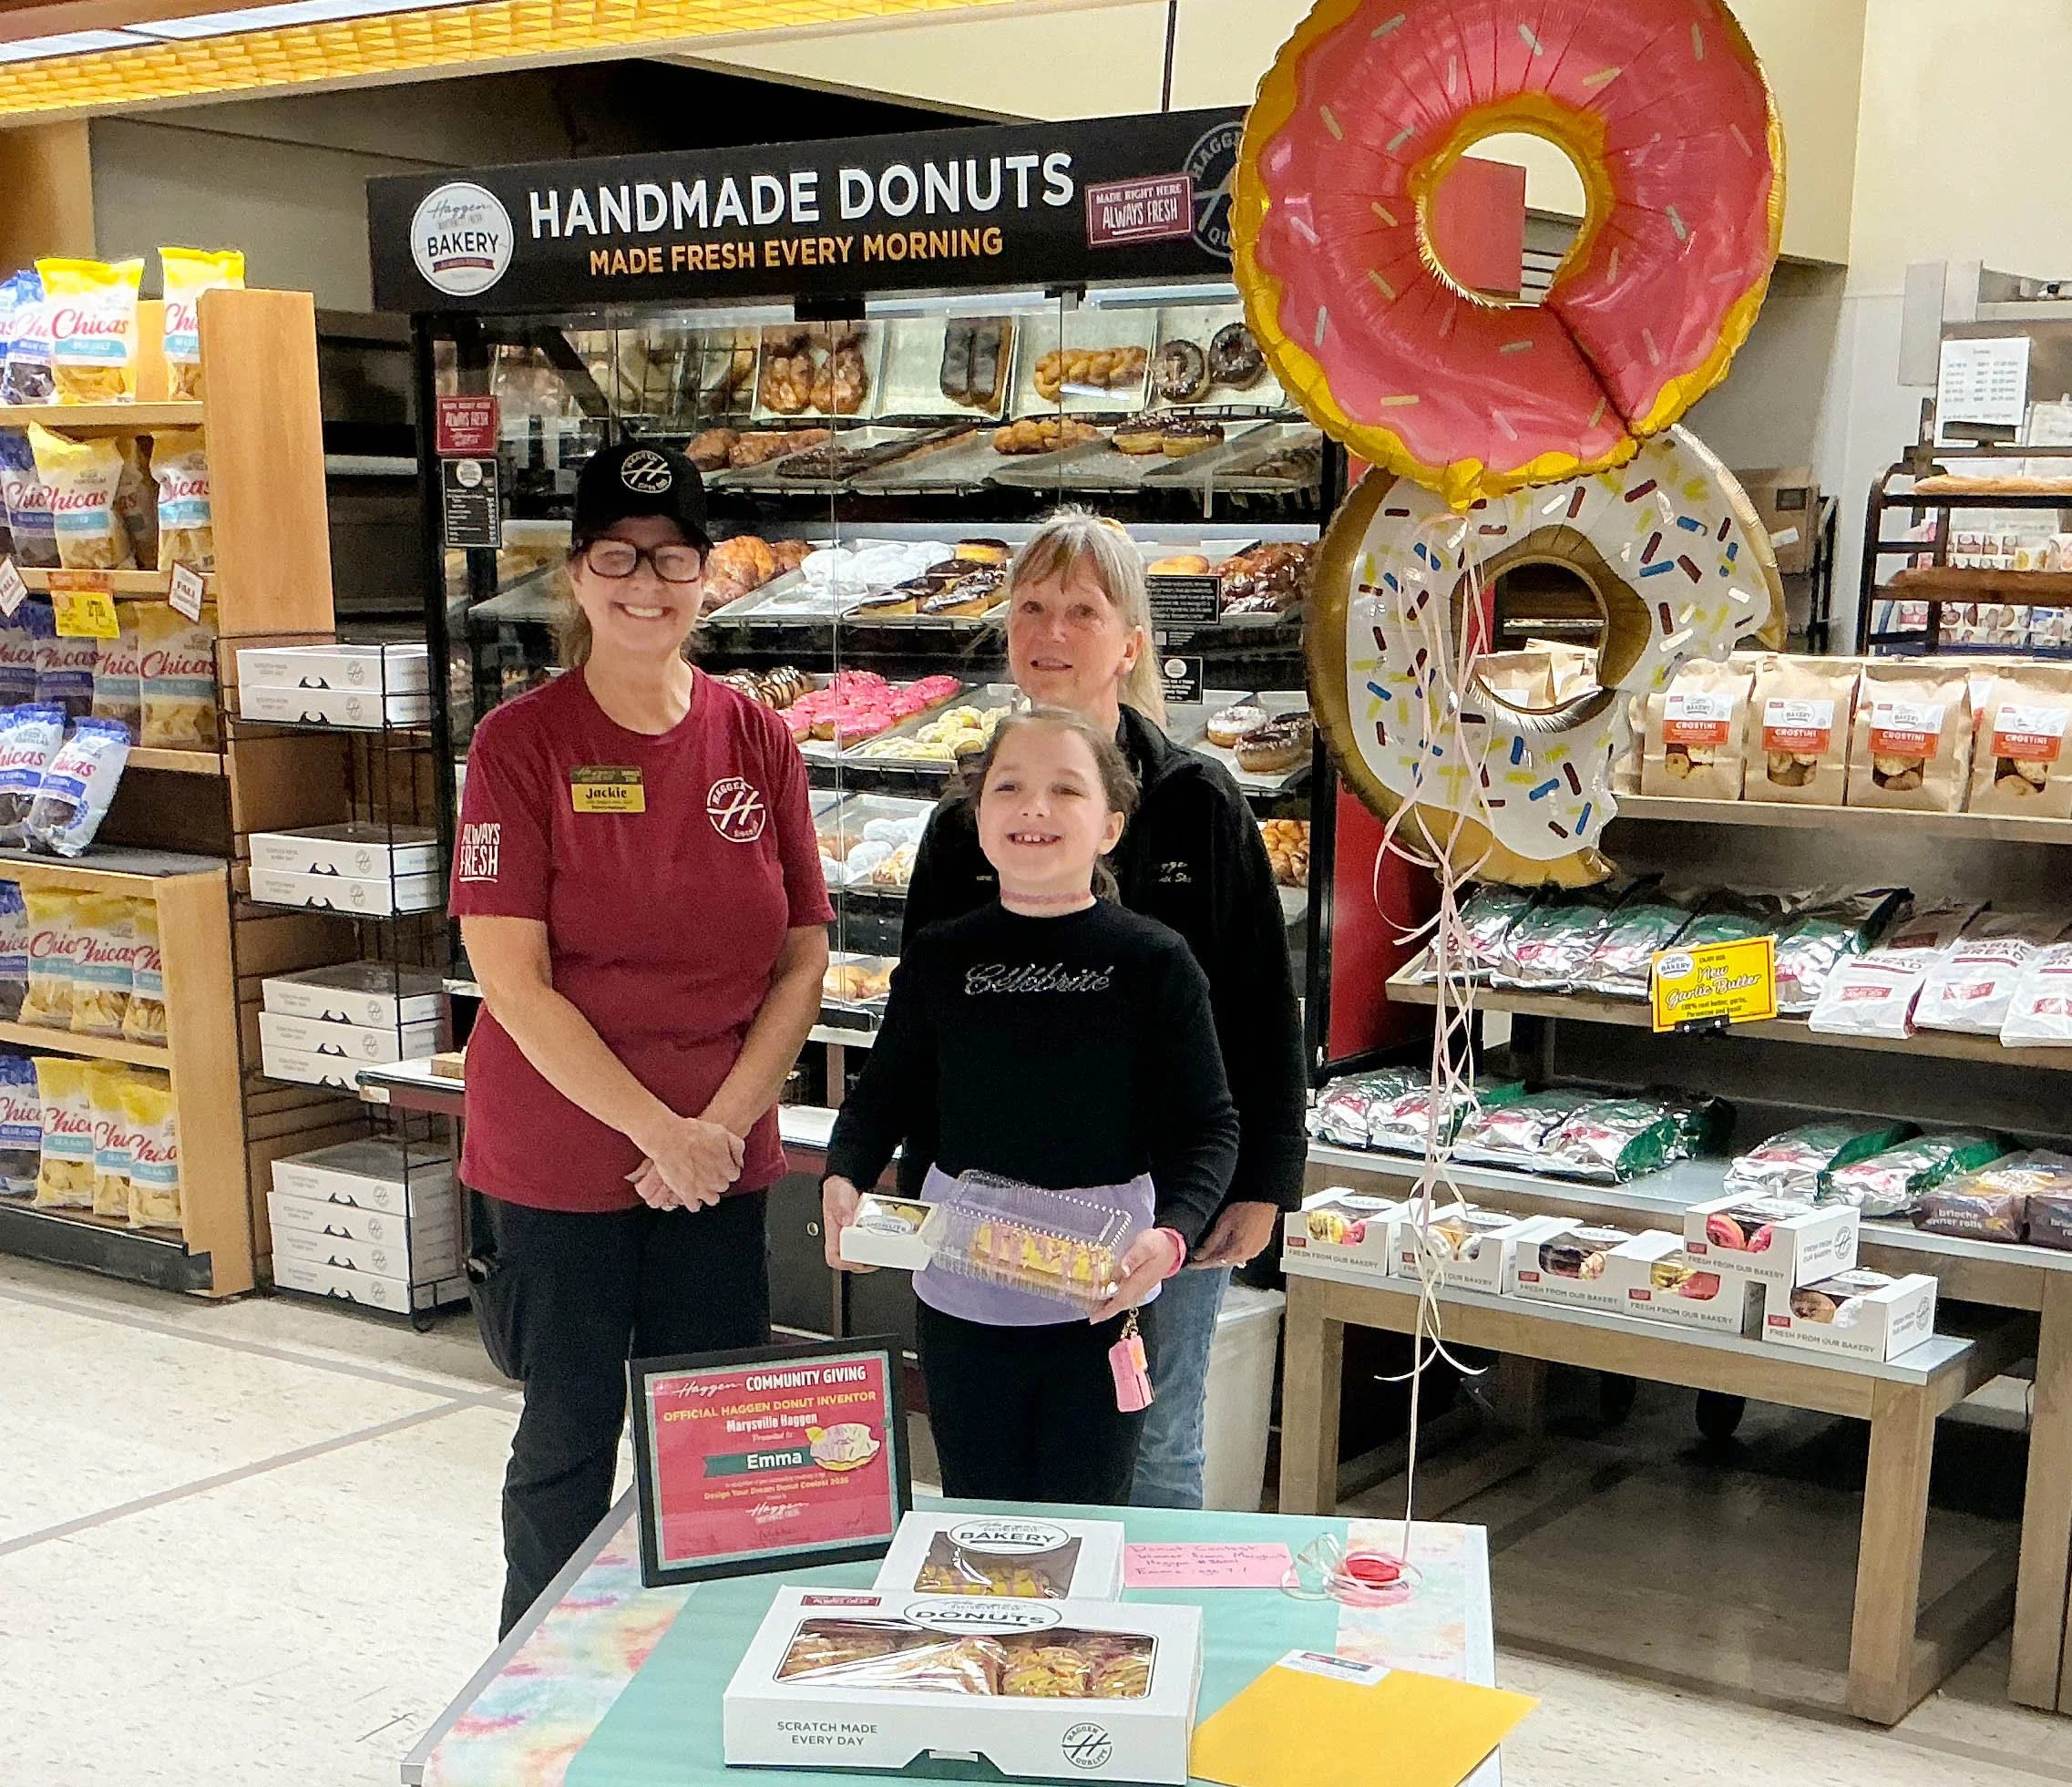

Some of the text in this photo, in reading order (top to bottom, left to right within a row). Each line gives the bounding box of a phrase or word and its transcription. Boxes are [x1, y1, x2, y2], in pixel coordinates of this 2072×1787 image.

[529, 152, 1074, 239] HANDMADE DONUTS
[1124, 186, 1154, 200] RIGHT
[1156, 183, 1183, 197] HERE
[1102, 197, 1178, 231] ALWAYS FRESH
[427, 231, 498, 257] BAKERY
[590, 227, 1003, 276] MADE FRESH EVERY MORNING
[52, 308, 129, 339] Chicas
[140, 651, 218, 679] Chicas
[1675, 721, 1717, 730] CROSTINI
[1774, 729, 1817, 737] CROSTINI
[1882, 730, 1924, 742] CROSTINI
[2005, 733, 2047, 745] CROSTINI
[585, 786, 628, 799] Jackie
[461, 823, 500, 845] ALWAYS
[459, 845, 498, 877] FRESH
[1661, 961, 1691, 971] BAKERY
[1698, 966, 1728, 982] New
[1666, 974, 1761, 1011] Garlic Butter
[1938, 1208, 1979, 1220] brioche
[1958, 1218, 1983, 1229] rolls
[1288, 1249, 1378, 1268] FRESH FROM OUR BAKERY
[1688, 1255, 1784, 1279] FRESH FROM OUR BAKERY
[1463, 1276, 1492, 1286] BAKERY
[1520, 1283, 1618, 1304] FRESH FROM OUR BAKERY
[1630, 1301, 1733, 1325] FRESH FROM OUR BAKERY
[1769, 1328, 1875, 1353] FRESH FROM OUR BAKERY
[672, 1366, 867, 1398] Haggen COMMUNITY GIVING
[663, 1391, 877, 1422] OFFICIAL HAGGEN DONUT INVENTOR
[726, 1412, 818, 1433] Marysville Haggen
[746, 1451, 803, 1470] Emma
[703, 1491, 731, 1501] Design
[744, 1502, 810, 1517] Haggen
[960, 1532, 1055, 1543] BAKERY
[916, 1611, 1045, 1624] DONUTS
[777, 1720, 877, 1734] SCRATCH MADE
[1067, 1726, 1099, 1741] HAGGEN
[792, 1734, 865, 1746] EVERY DAY
[1076, 1749, 1108, 1765] QUALITY
